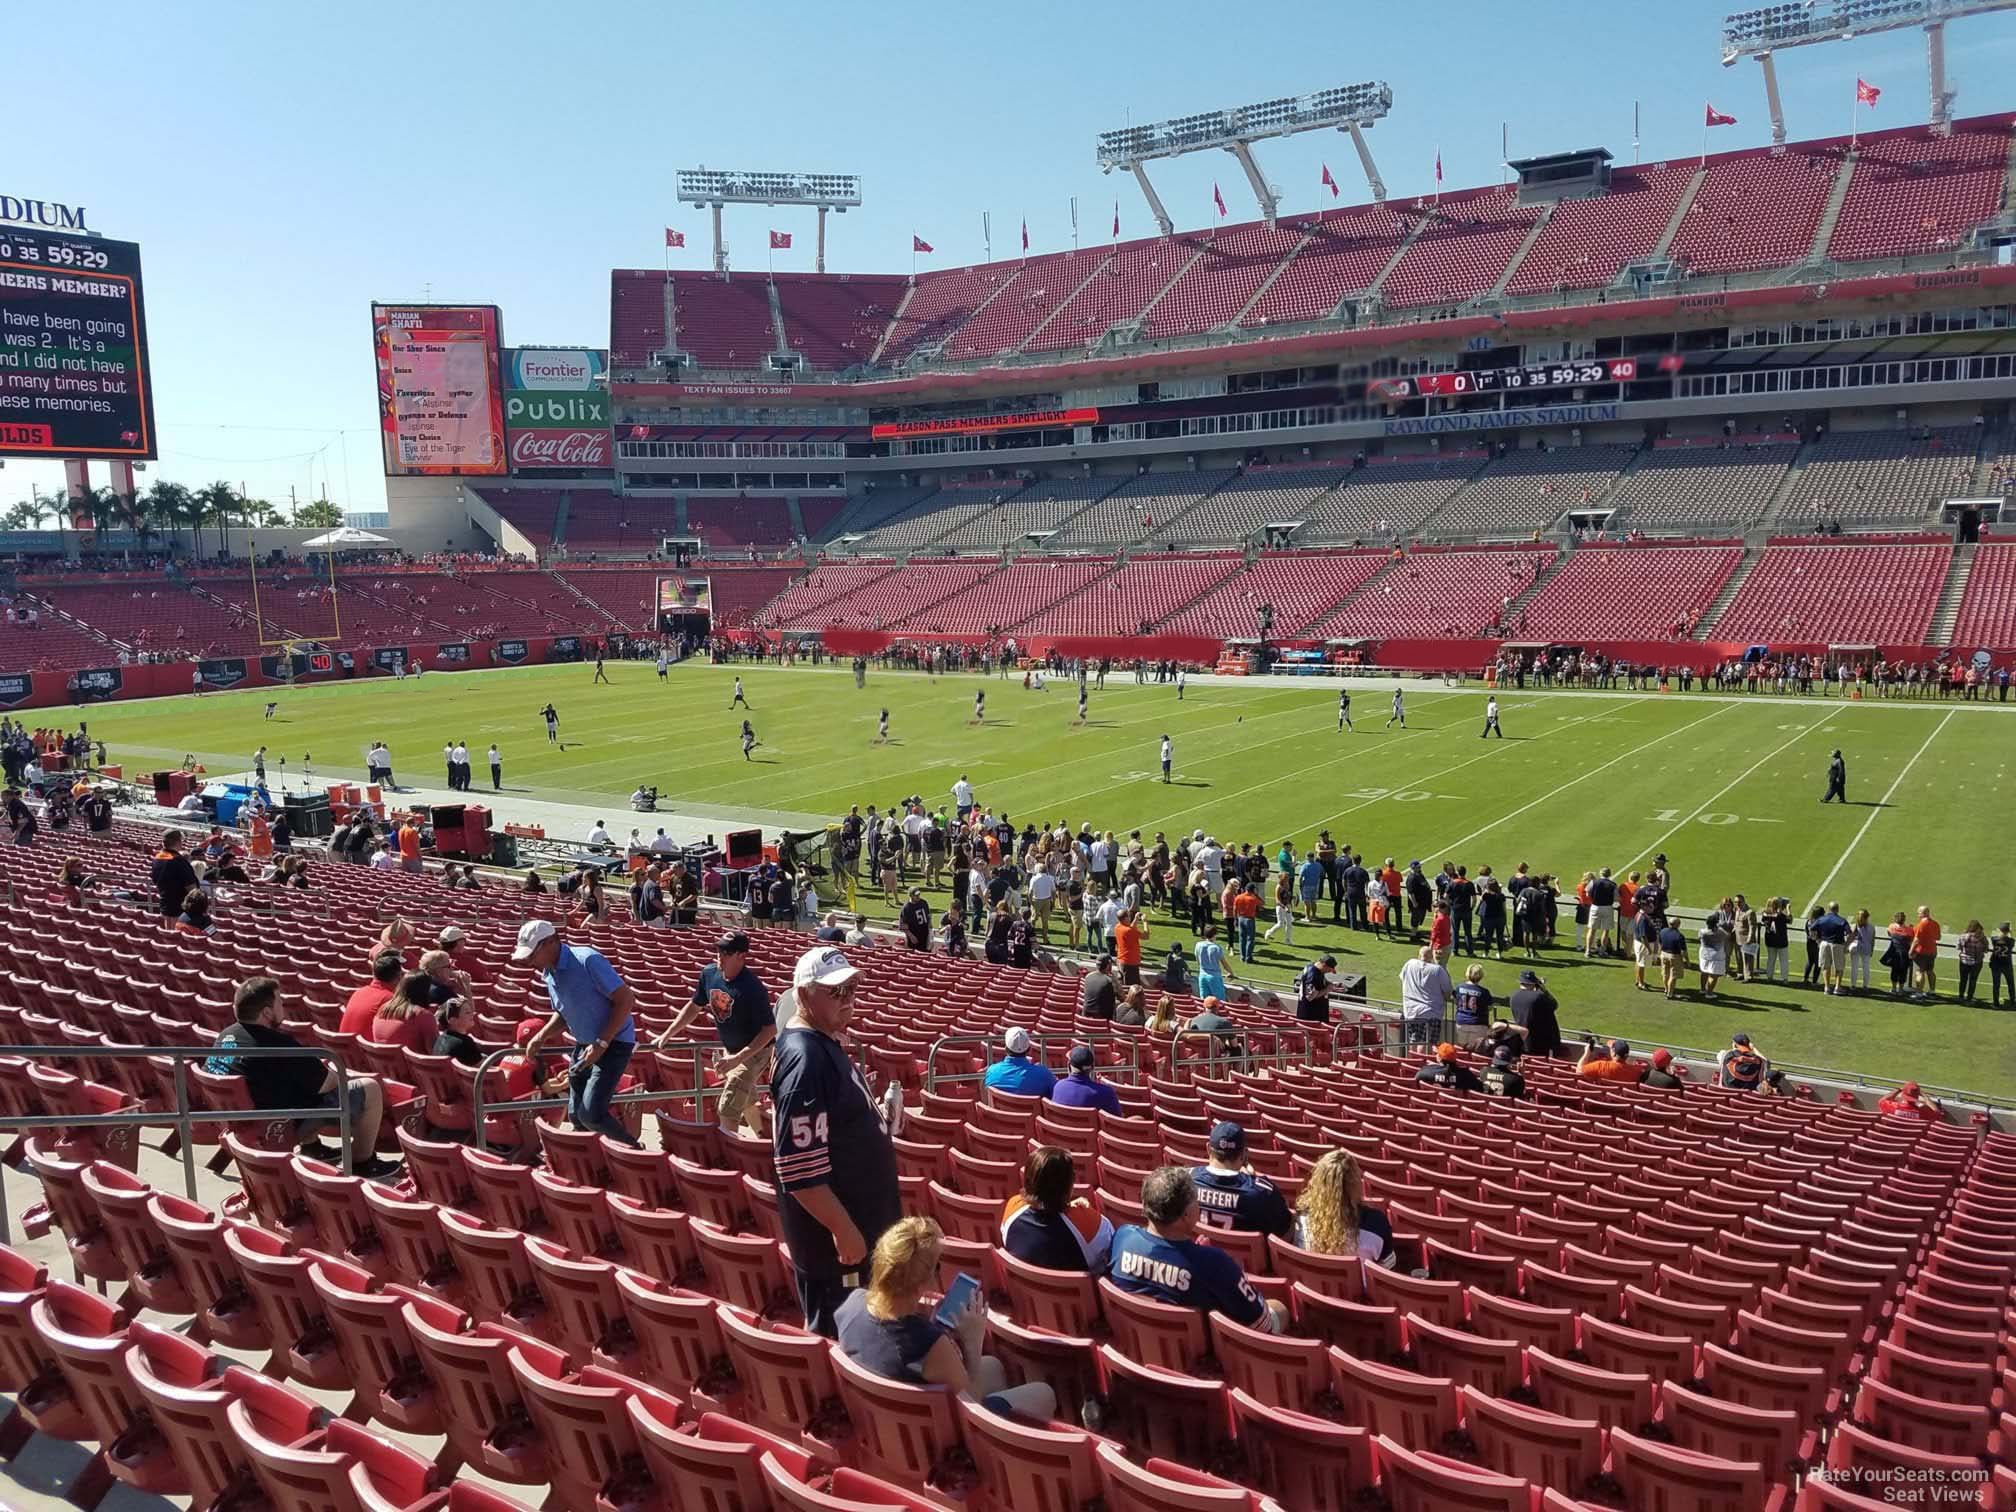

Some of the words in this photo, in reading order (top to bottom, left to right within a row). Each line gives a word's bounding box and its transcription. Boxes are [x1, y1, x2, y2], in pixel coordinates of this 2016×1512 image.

[0, 195, 87, 230] DIUM
[19, 246, 40, 260] 35
[47, 246, 108, 268] 59:29
[52, 278, 126, 298] MEMBER?
[3, 308, 39, 327] have
[45, 312, 81, 330] been
[87, 318, 125, 337] going
[5, 333, 36, 348] was
[41, 333, 56, 348] 2.
[68, 335, 91, 352] It's
[96, 340, 105, 352] a
[24, 352, 28, 367] I
[34, 353, 57, 369] did
[62, 357, 87, 372] not
[91, 356, 125, 374] have
[526, 362, 586, 376] Frontier
[9, 374, 50, 392] many
[55, 375, 97, 392] times
[102, 378, 126, 394] but
[1455, 376, 1466, 391] 0
[1506, 376, 1521, 387] 10
[1529, 373, 1546, 385] 35
[1552, 367, 1603, 384] 59:29
[1612, 364, 1633, 376] 40
[707, 386, 722, 394] FAN
[0, 395, 30, 408] ese
[35, 396, 115, 413] memories.
[508, 398, 602, 421] Publix
[896, 423, 931, 433] SEASON
[933, 420, 957, 430] PASS
[960, 416, 1008, 428] MEMBERS
[1011, 411, 1067, 424] SPOTLIGHT
[1384, 416, 1471, 435] RAYMOND
[1473, 411, 1531, 430] JAMES
[1533, 405, 1618, 424] STADIUM
[404, 443, 418, 454] Eye
[421, 444, 428, 452] of
[431, 444, 444, 452] the
[446, 443, 465, 454] Tiger
[512, 432, 607, 464] Coca-Cola
[312, 656, 330, 670] 40
[94, 804, 103, 816] 17
[1645, 809, 1739, 825] 10
[752, 889, 763, 905] 13
[915, 908, 928, 925] 51
[1015, 931, 1026, 945] 22
[791, 1112, 829, 1148] 54
[1120, 1250, 1191, 1291] BUTKUS
